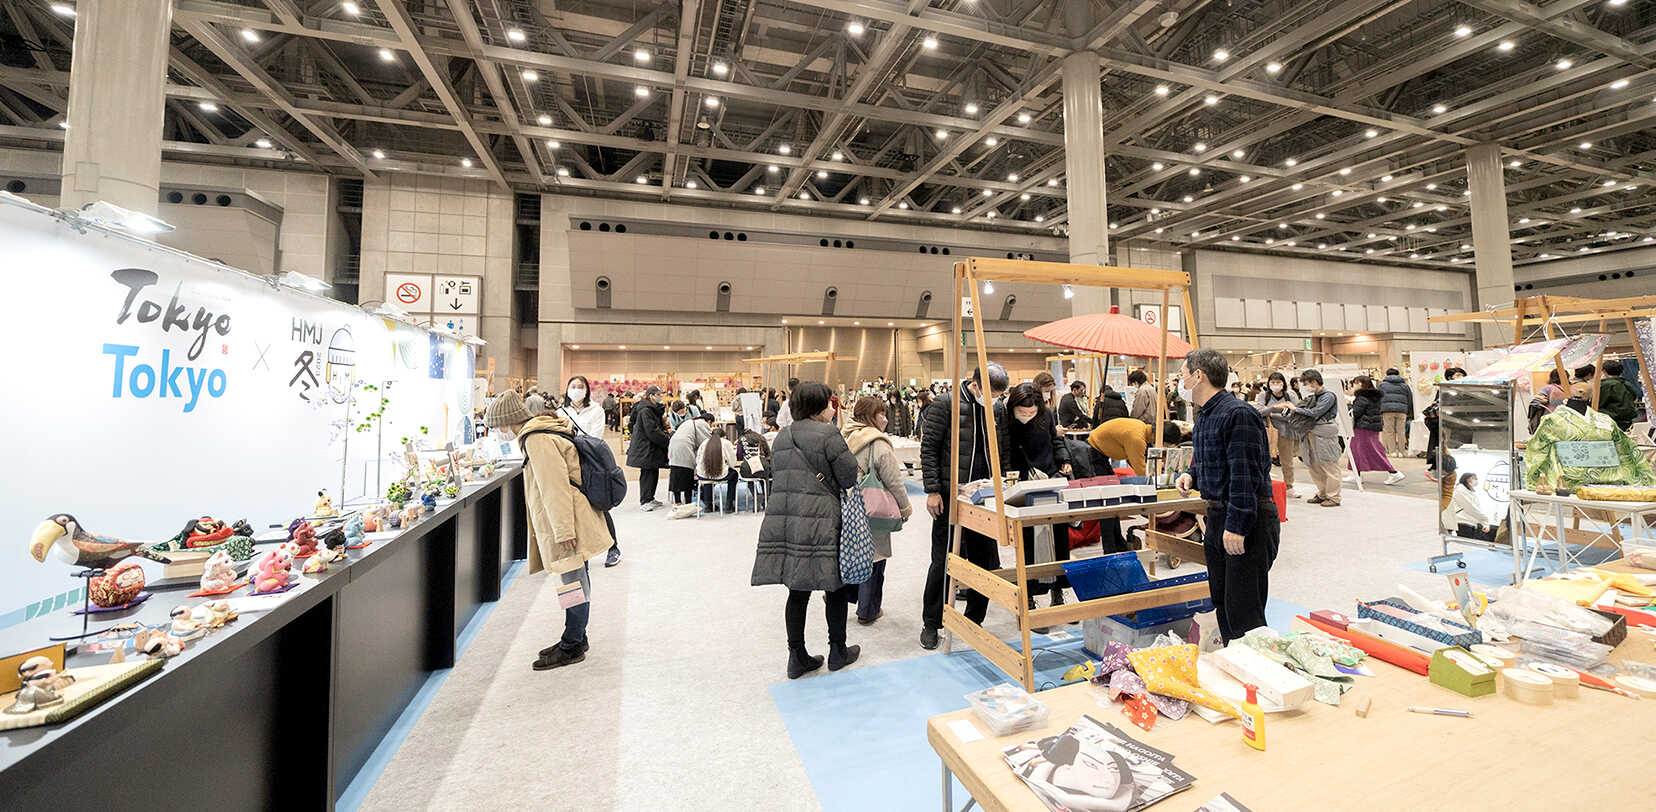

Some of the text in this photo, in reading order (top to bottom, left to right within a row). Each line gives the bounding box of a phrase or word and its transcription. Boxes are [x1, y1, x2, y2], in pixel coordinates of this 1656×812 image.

[110, 268, 231, 361] Tokyo
[291, 316, 323, 345] HMJ
[102, 343, 227, 413] Tokyo
